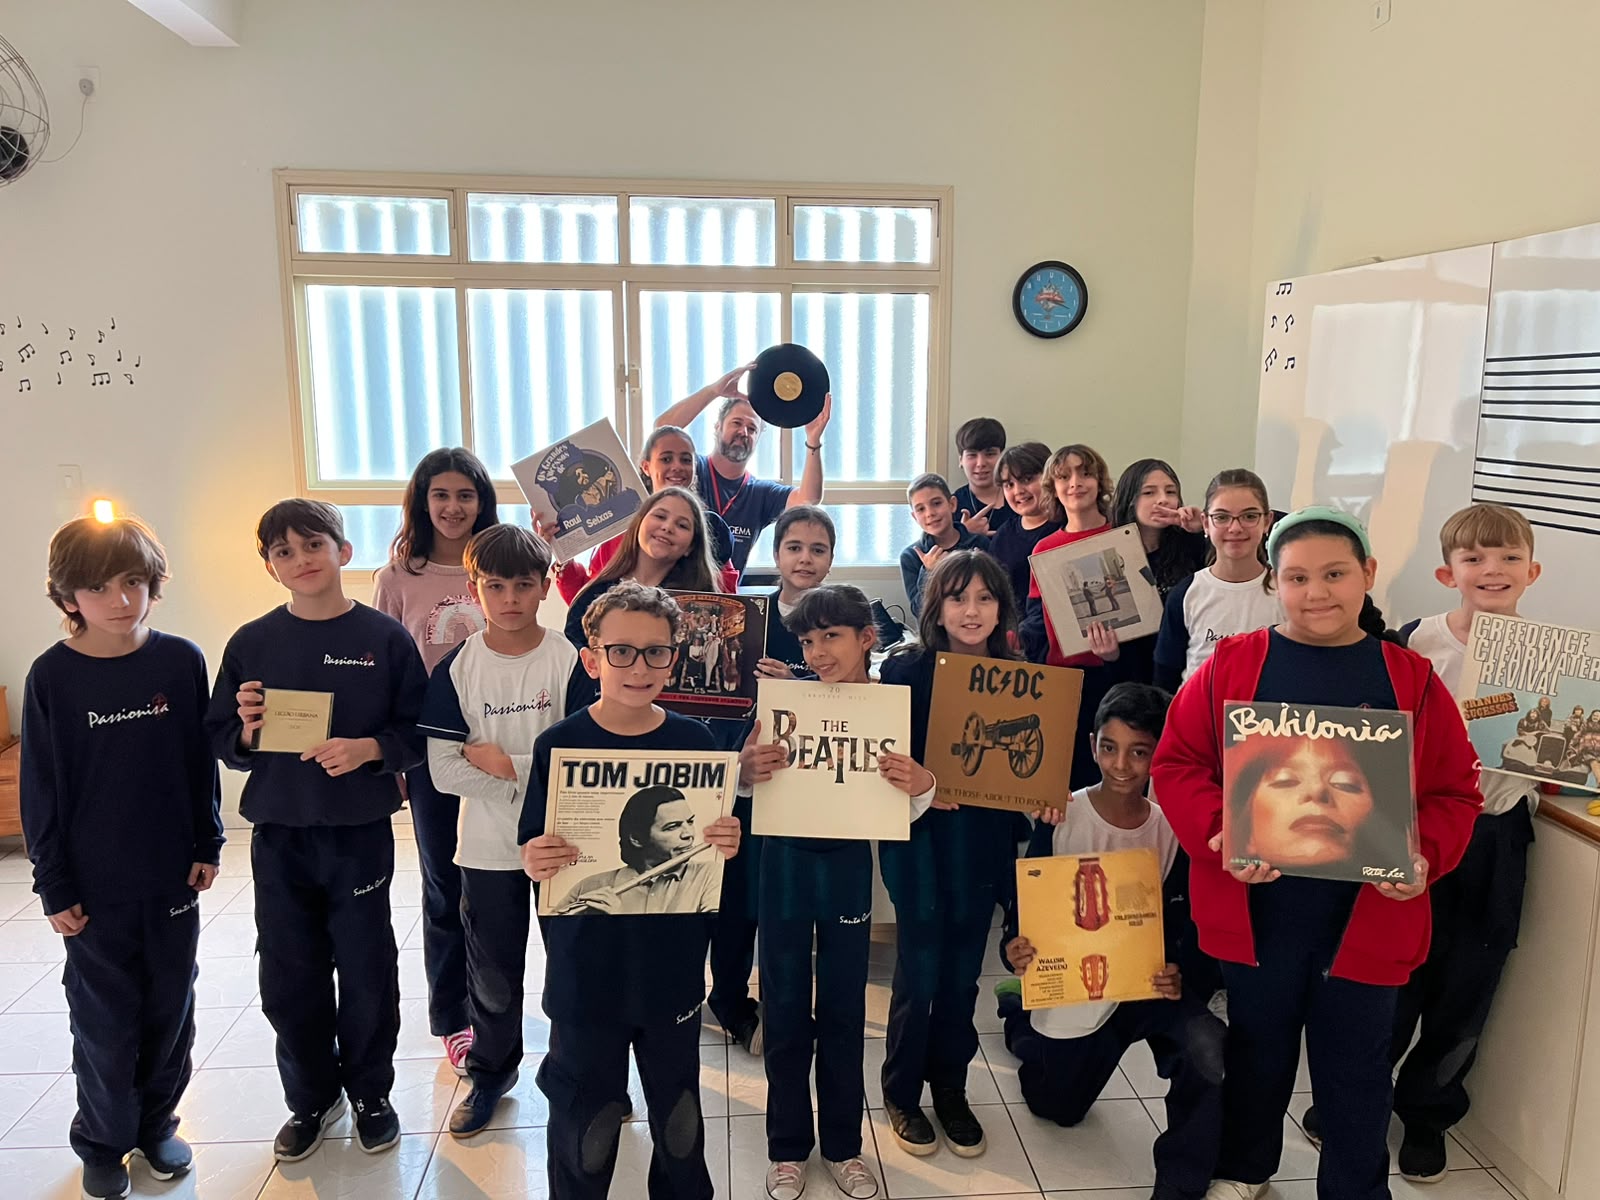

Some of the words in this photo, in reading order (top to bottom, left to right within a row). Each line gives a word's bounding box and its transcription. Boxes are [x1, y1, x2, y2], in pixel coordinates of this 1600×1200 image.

[541, 443, 569, 470] Grandes
[562, 513, 582, 530] Raul
[585, 509, 614, 528] Seixas
[1474, 614, 1590, 656] CREEDENCE
[1473, 633, 1600, 682] CLEARWATER
[1479, 658, 1559, 697] REVIVAL
[829, 686, 841, 694] 20
[1462, 691, 1515, 710] GRANDES
[1463, 701, 1519, 721] SUCESSOS
[821, 719, 849, 733] THE
[771, 709, 897, 784] BEATLES
[562, 760, 629, 788] TOM
[633, 761, 727, 788] JOBIM
[954, 788, 982, 800] THOSE
[984, 791, 1012, 802] ABOUT
[1014, 796, 1026, 804] TO
[1026, 797, 1052, 808] ROCK
[839, 915, 862, 925] Santa
